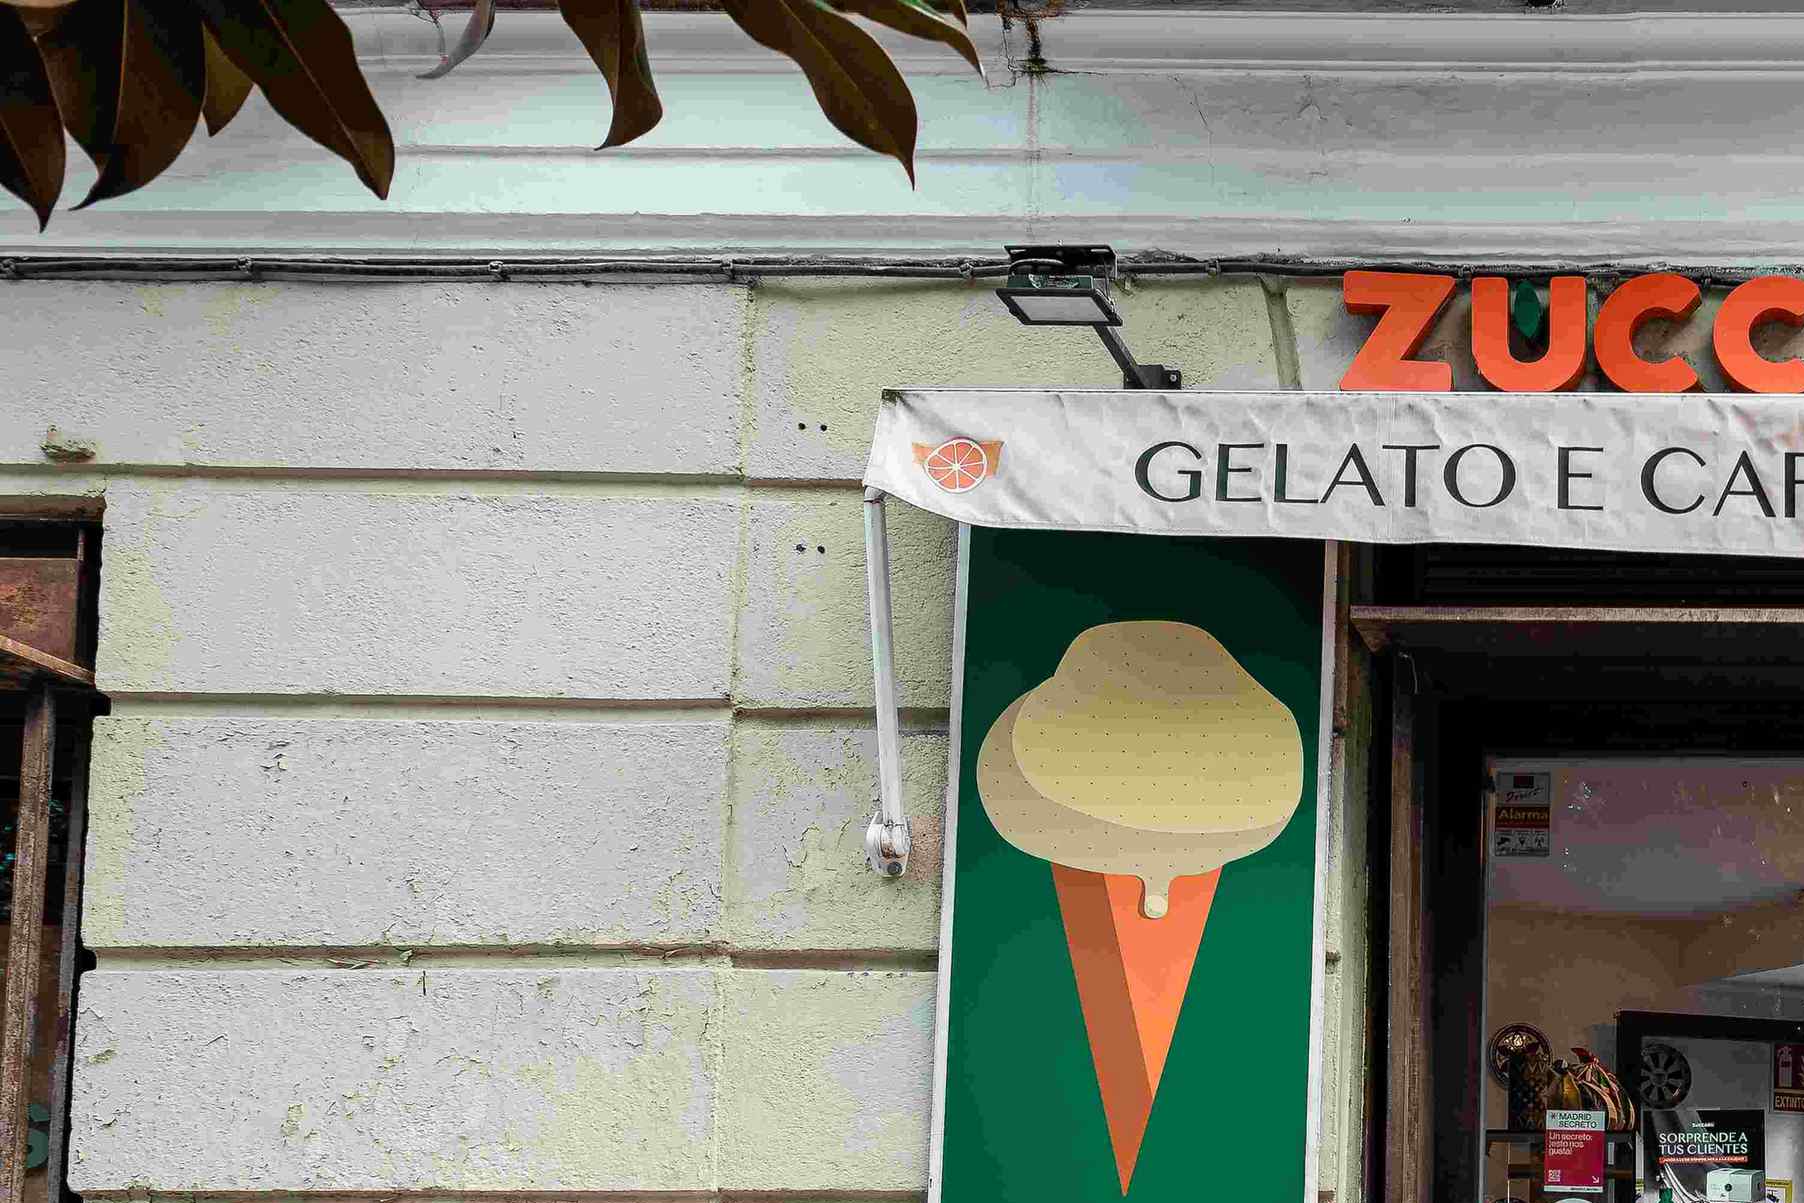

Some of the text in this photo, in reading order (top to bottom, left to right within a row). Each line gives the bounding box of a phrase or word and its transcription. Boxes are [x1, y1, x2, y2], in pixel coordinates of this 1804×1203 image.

[1134, 440, 1517, 512] GELATO
[1556, 446, 1605, 511] E
[1559, 1113, 1592, 1121] MADRID
[1559, 1120, 1597, 1128] SECRETO
[1659, 1132, 1748, 1144] SORPRENDE A
[1659, 1143, 1748, 1155] TUS CLIENTES
